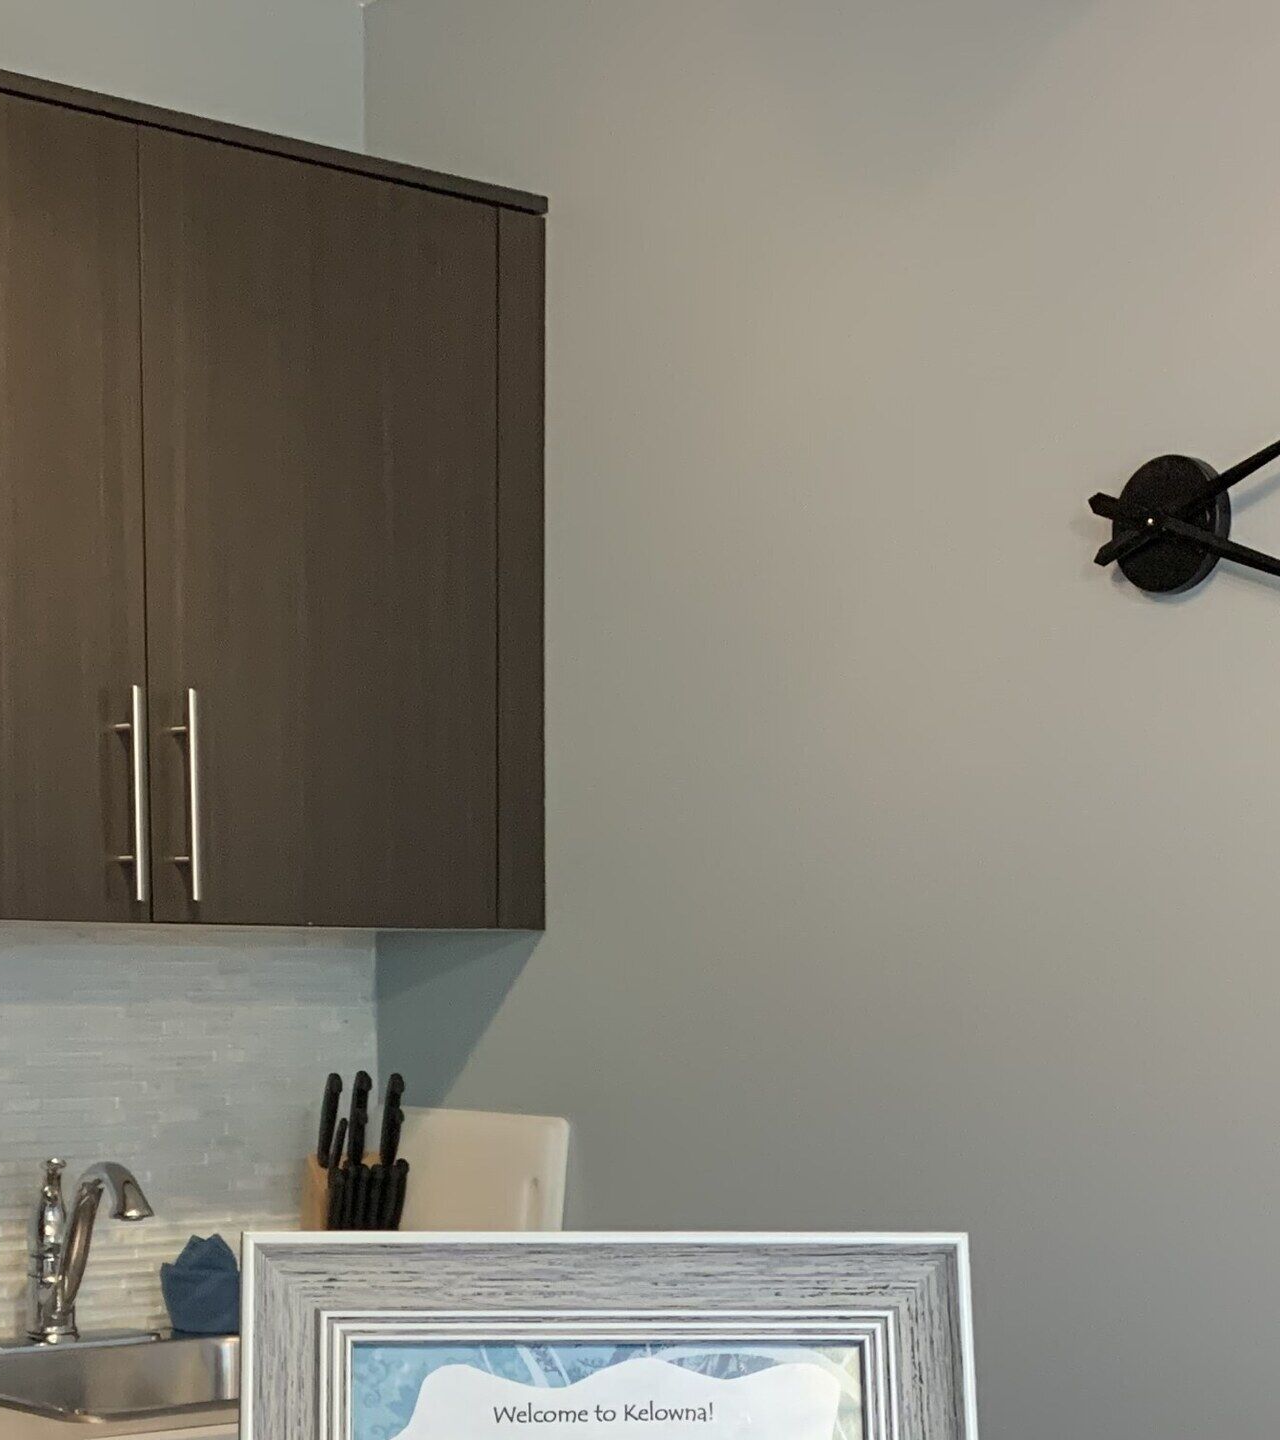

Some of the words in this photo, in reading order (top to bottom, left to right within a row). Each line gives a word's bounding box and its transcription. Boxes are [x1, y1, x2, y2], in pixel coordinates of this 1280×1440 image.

[492, 1401, 589, 1424] Welcome
[593, 1403, 617, 1423] to
[623, 1399, 713, 1423] Kelowna!
